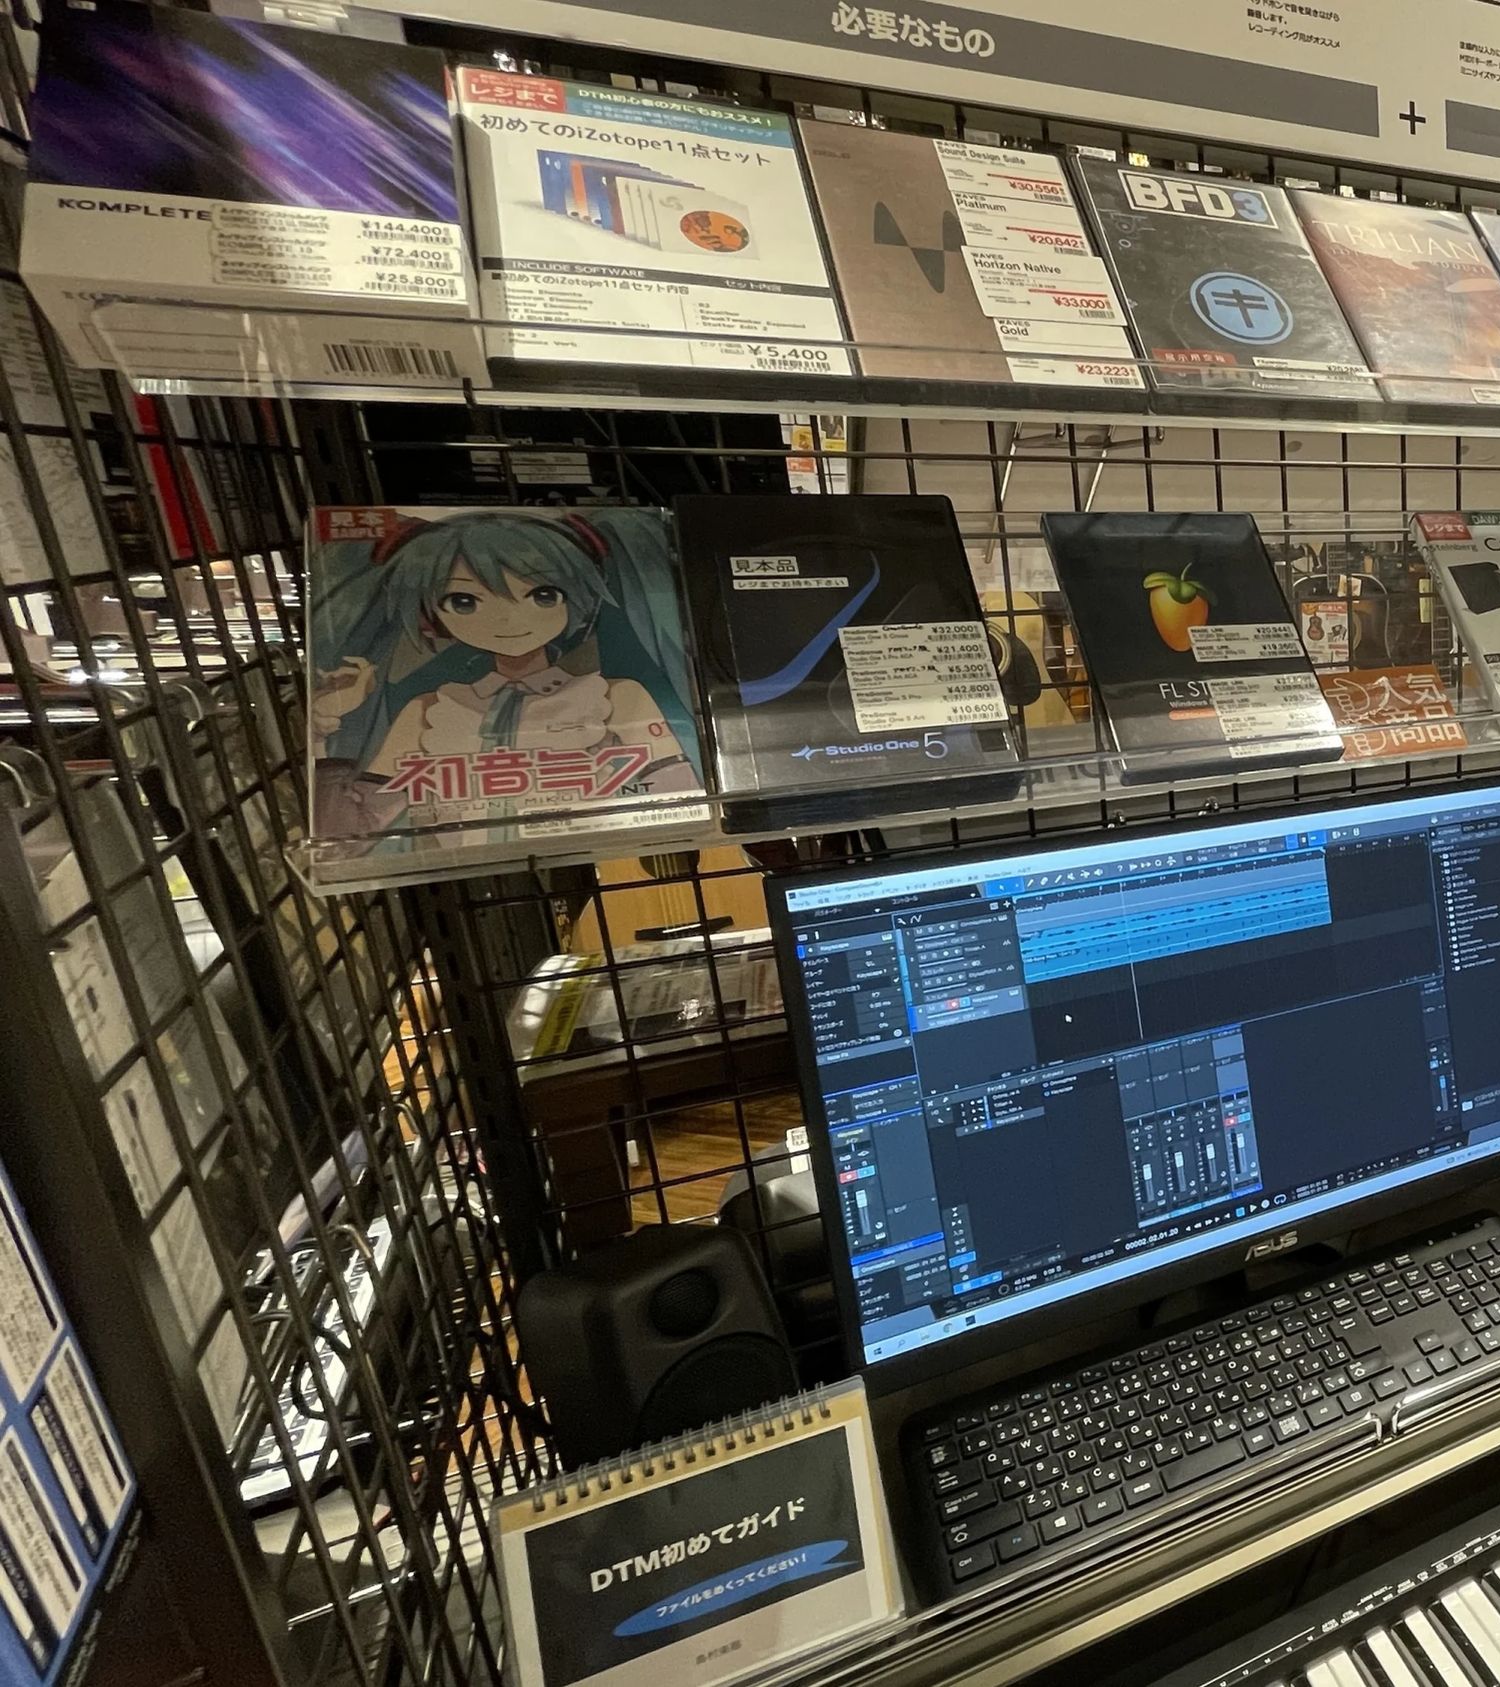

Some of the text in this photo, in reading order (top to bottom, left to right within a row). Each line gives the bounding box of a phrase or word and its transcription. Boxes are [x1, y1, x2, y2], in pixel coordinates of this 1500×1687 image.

[830, 1, 996, 58] 必要なもの
[469, 84, 557, 105] レジまで
[480, 112, 771, 166] 初めてのiZotope11点セット
[938, 146, 967, 158] Sound
[969, 151, 1000, 163] Design
[956, 198, 1007, 212] Platinum
[1130, 174, 1269, 222] BFD3
[58, 198, 211, 221] KOMPLETE
[1312, 220, 1485, 266] TRILIAN
[971, 252, 1004, 260] WAVES
[511, 260, 646, 279] INCLUDE SOFTWARE
[973, 258, 1062, 274] Horizon Native
[1000, 325, 1029, 336] Gold
[331, 512, 384, 527] 見本
[331, 528, 385, 539] SAMPLE
[1424, 523, 1464, 534] レジまで
[733, 558, 796, 575] 見本品
[1159, 683, 1184, 699] FL
[1367, 674, 1447, 710] 人気
[825, 732, 948, 759] Studio One 5
[376, 745, 652, 805] 初音ミク
[620, 782, 655, 795] NT
[524, 795, 575, 804] MIKU
[1124, 1227, 1179, 1253] 00002.02.01.20
[1244, 1231, 1299, 1262] ASUS
[944, 1491, 978, 1508] Caps Lock
[951, 1523, 967, 1533] Shift
[590, 1497, 805, 1593] DTM初めてガイド
[959, 1557, 973, 1567] Ctrl
[655, 1552, 809, 1618] ファイルをめくってください！
